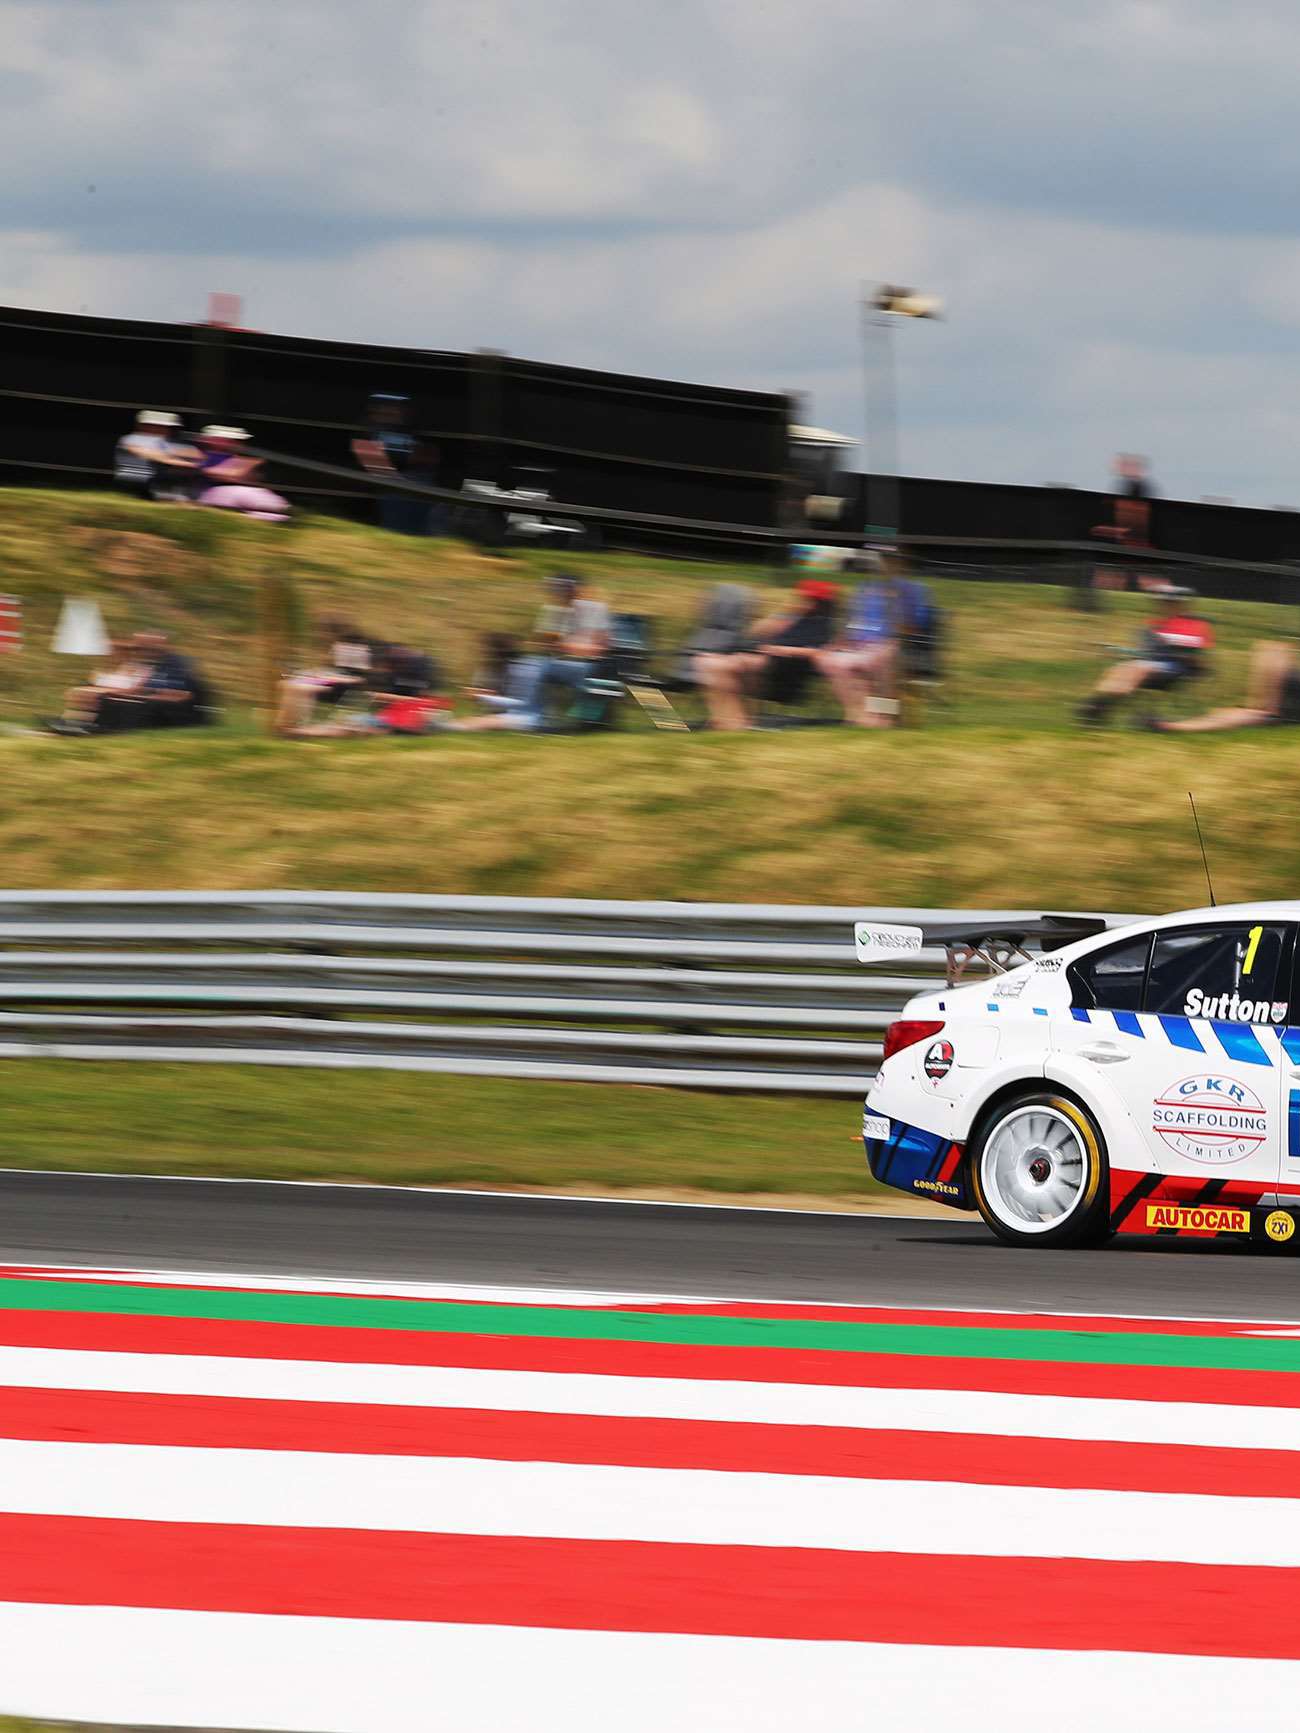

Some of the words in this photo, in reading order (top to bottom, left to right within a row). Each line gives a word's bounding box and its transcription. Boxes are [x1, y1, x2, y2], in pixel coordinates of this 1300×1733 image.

[1242, 926, 1264, 975] 1
[1183, 988, 1271, 1024] Sutton
[1179, 1078, 1246, 1103] GKR
[1153, 1109, 1267, 1131] SCAFFOLDING
[1175, 1137, 1246, 1158] LIMITED
[913, 1179, 960, 1196] GOODYEAR
[1152, 1208, 1245, 1230] AUTOCAR
